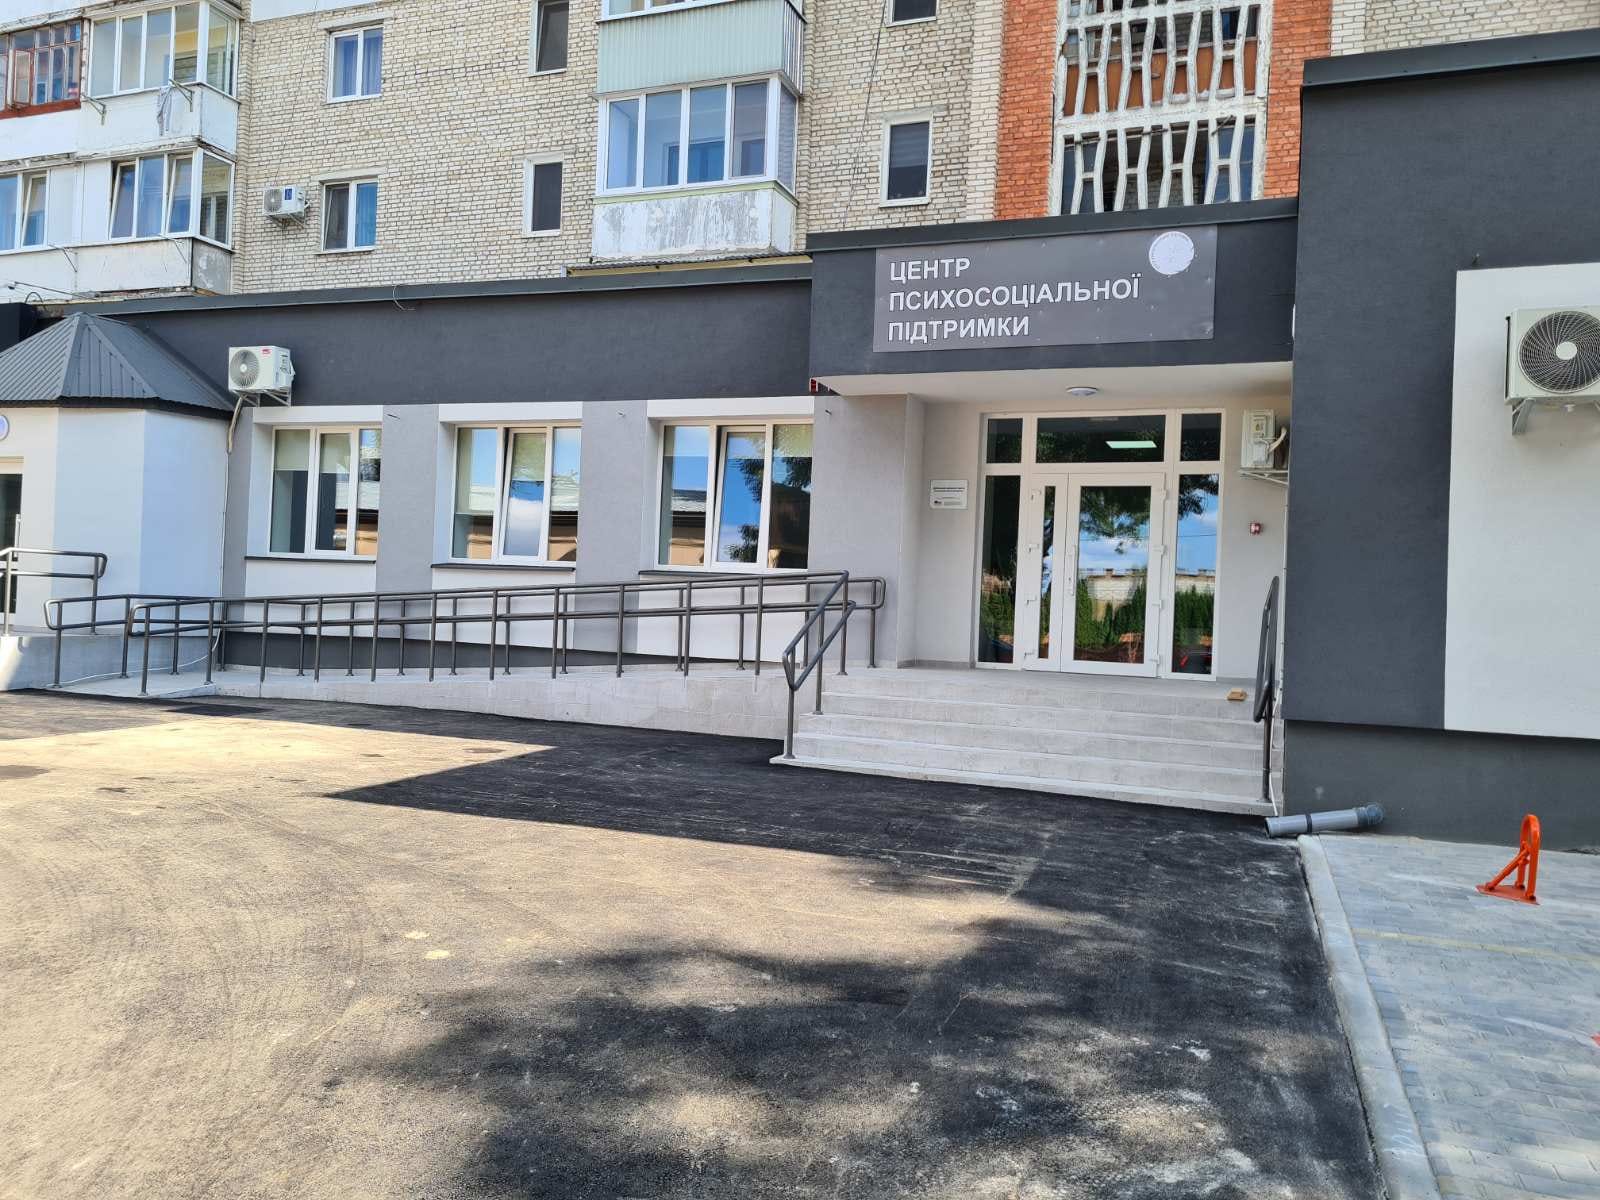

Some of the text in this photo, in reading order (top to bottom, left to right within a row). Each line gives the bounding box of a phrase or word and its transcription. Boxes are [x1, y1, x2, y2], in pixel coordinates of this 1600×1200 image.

[890, 257, 970, 283] ЦЕНТР
[889, 273, 1141, 311] ПСИХОСОЦІАЛЬНОЇ
[888, 316, 1029, 344] ПІДТРИМКИ
